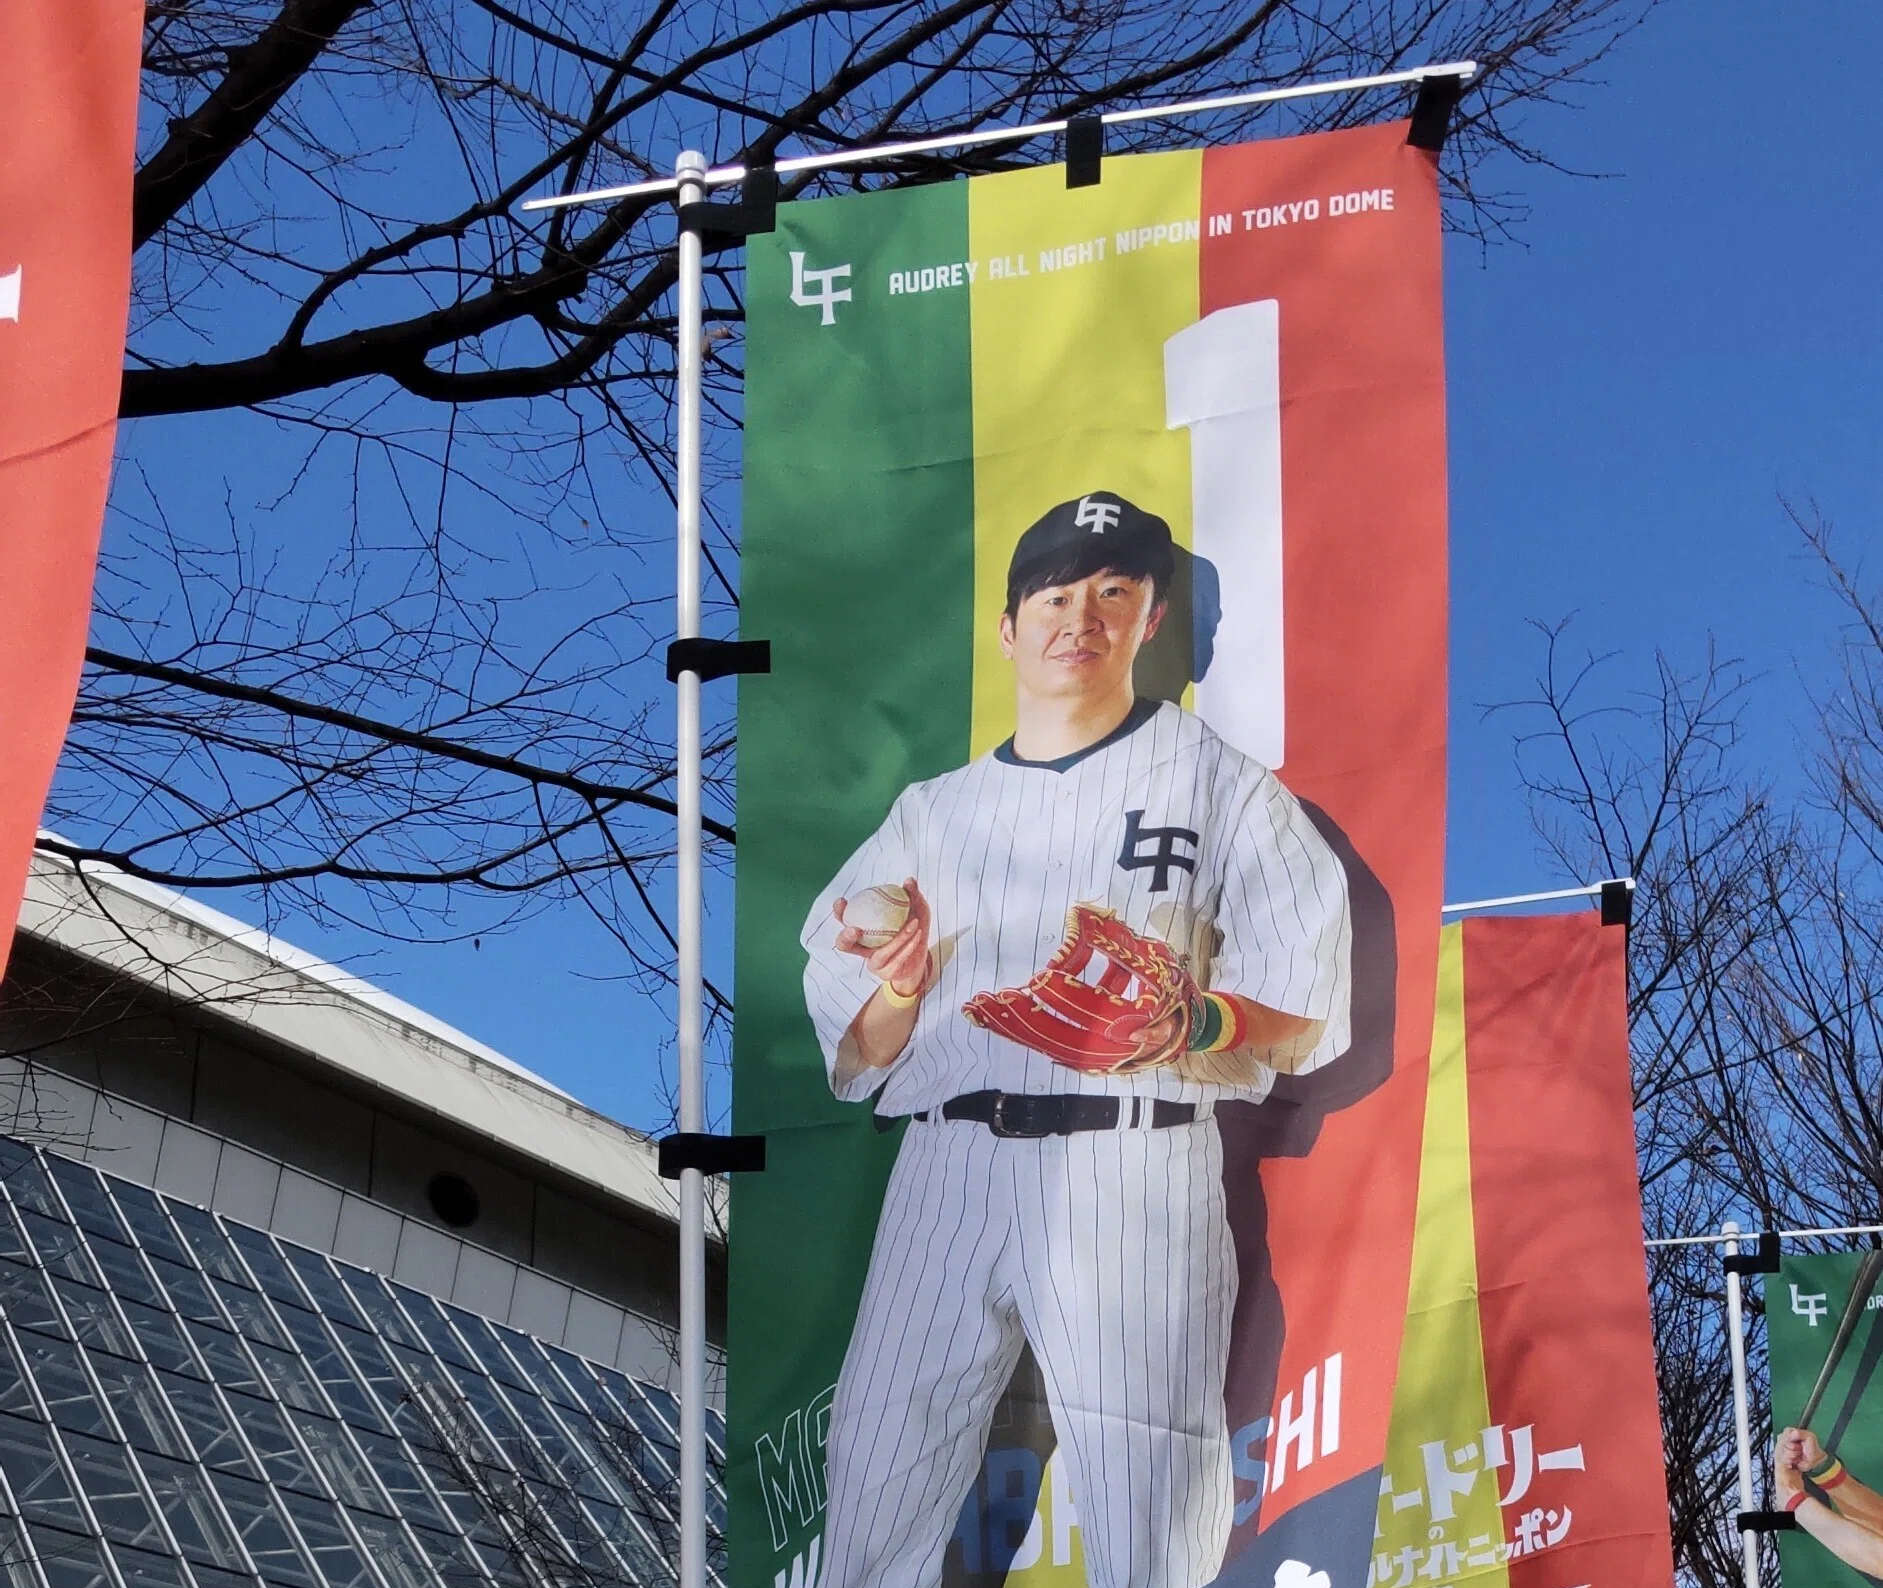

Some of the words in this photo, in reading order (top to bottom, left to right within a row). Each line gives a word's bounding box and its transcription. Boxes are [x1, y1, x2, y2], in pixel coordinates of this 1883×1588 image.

[889, 260, 980, 296] AUDREY
[988, 254, 1030, 280] ALL
[1039, 237, 1107, 273] NIGHT
[1116, 219, 1200, 255] NIPPON
[1209, 213, 1233, 237] IN
[1242, 198, 1320, 230] TOKYO
[1329, 188, 1395, 217] DOME
[1428, 1525, 1445, 1541] の
